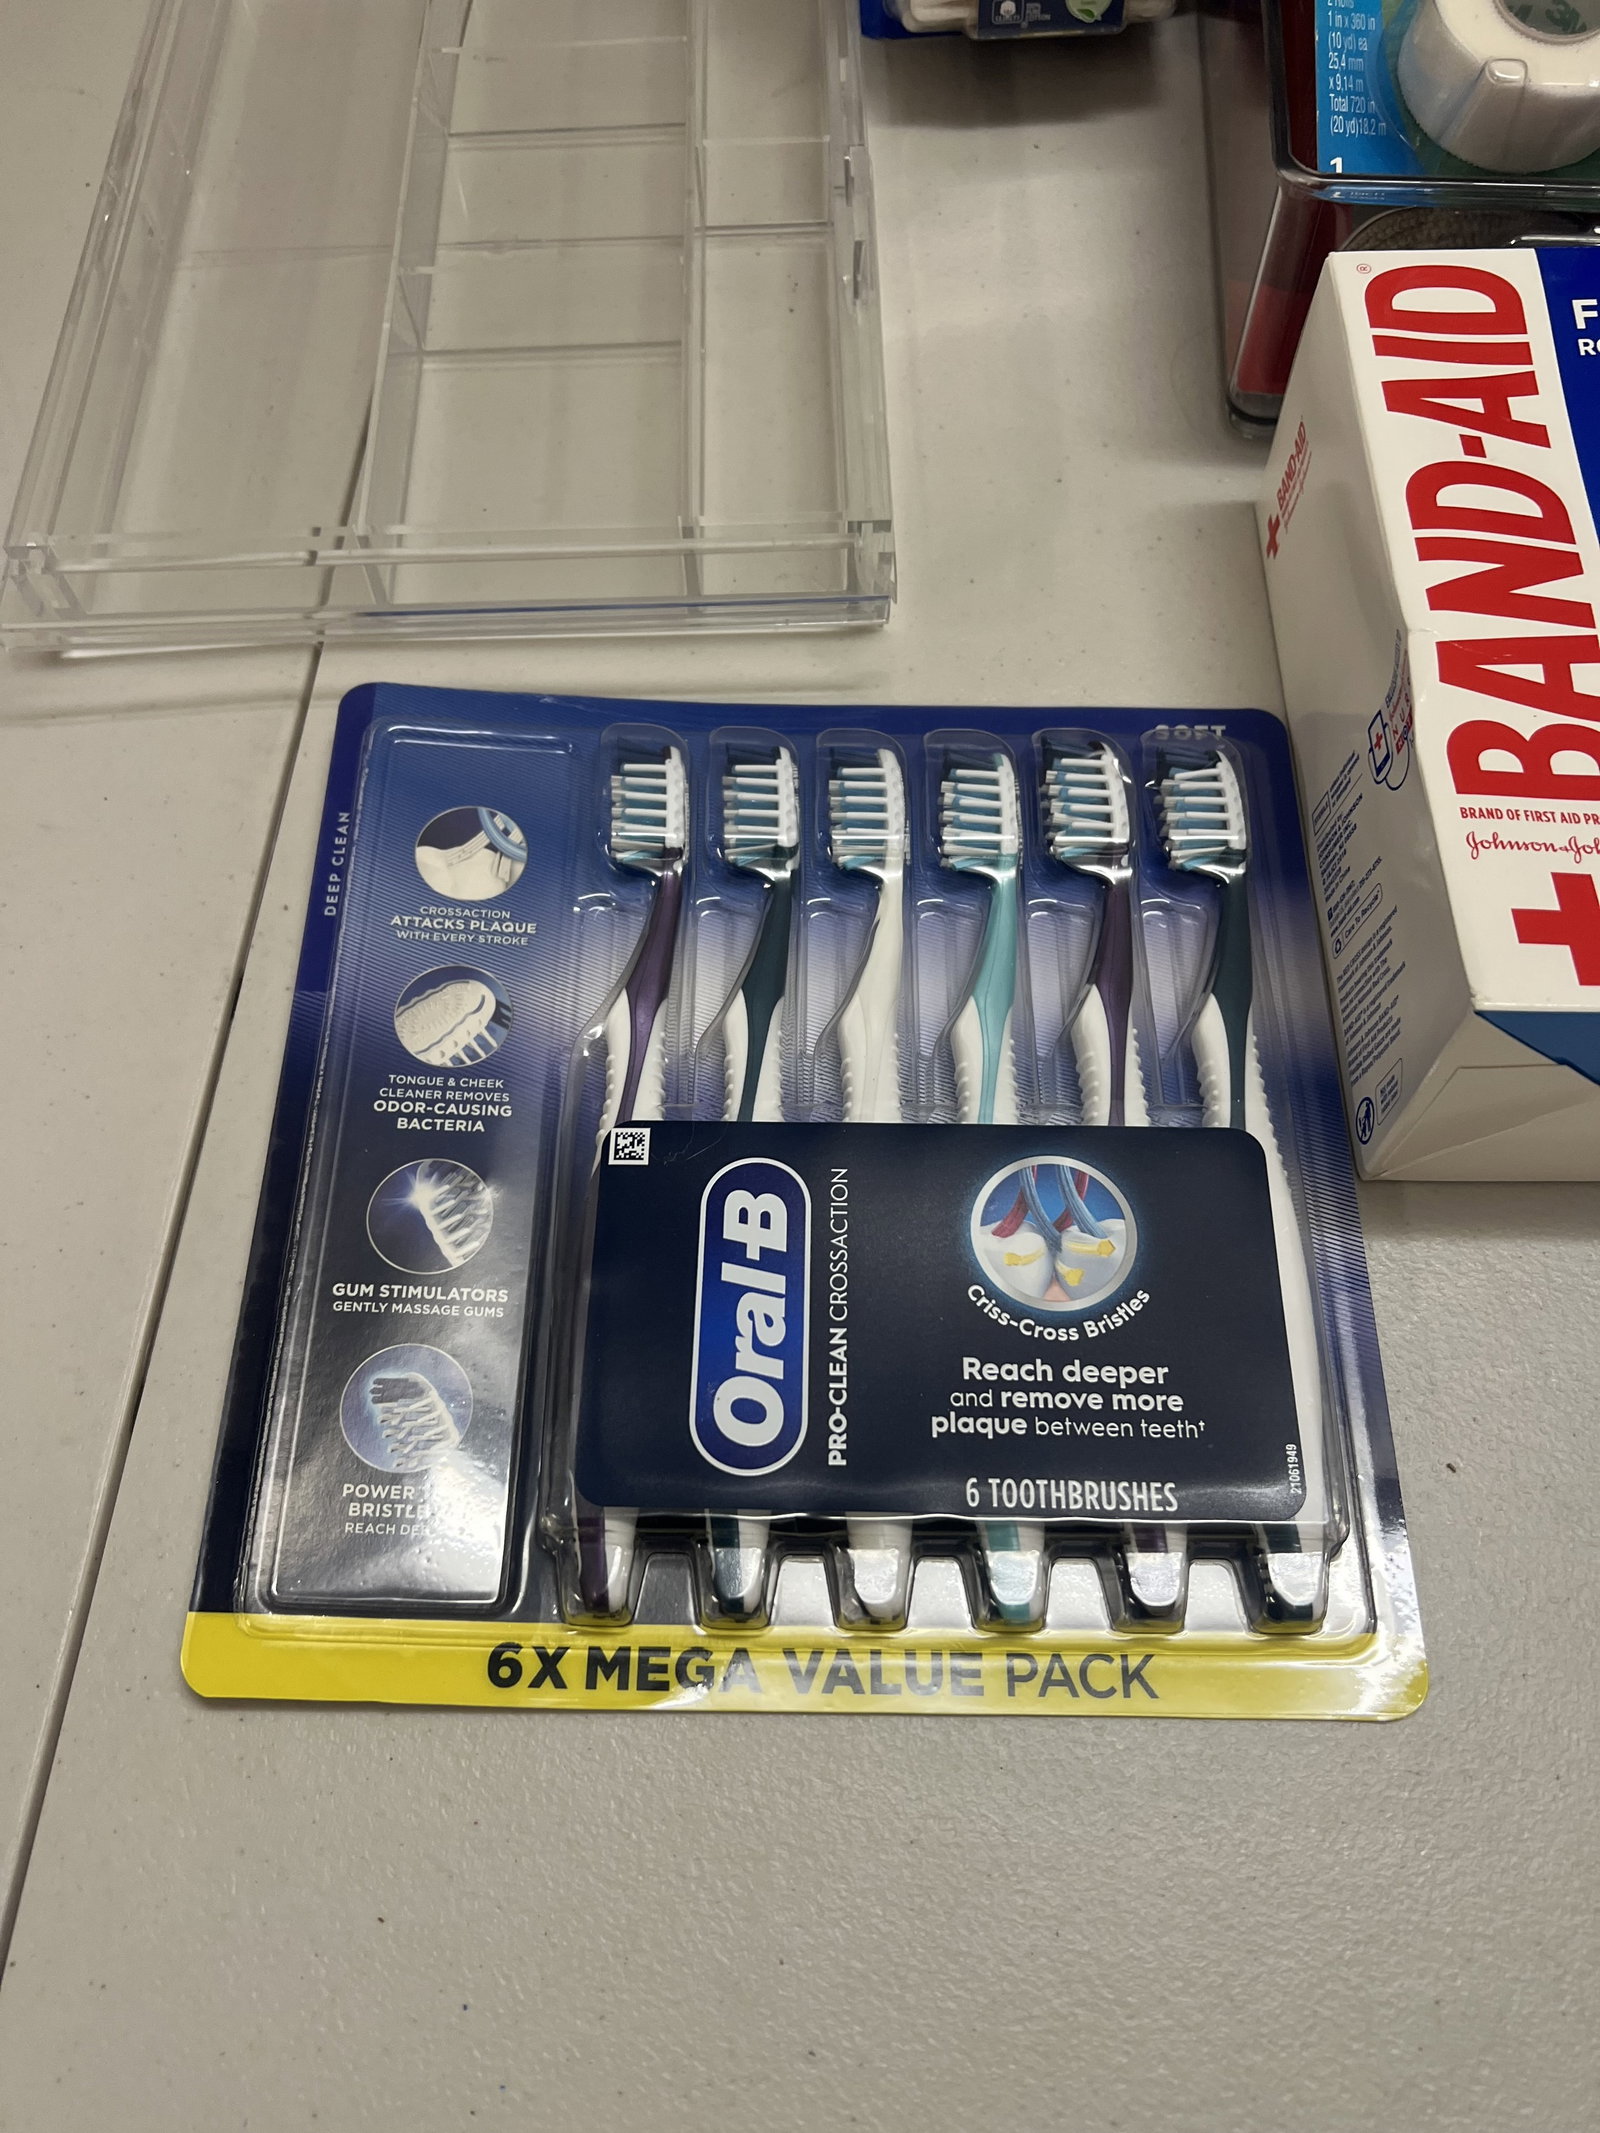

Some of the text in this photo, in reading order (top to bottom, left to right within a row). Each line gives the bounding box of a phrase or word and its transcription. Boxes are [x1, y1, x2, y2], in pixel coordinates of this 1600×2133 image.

[1328, 10, 1376, 31] 1 in x 360 in
[1328, 31, 1342, 52] (10
[1358, 37, 1368, 51] ea
[1329, 76, 1335, 90] x
[1329, 94, 1348, 112] Total
[1350, 95, 1365, 114] 720
[1330, 115, 1344, 136] (20
[1460, 806, 1503, 820] BRAND
[1506, 808, 1521, 821] OF
[1523, 809, 1557, 823] FIRST
[1560, 811, 1581, 824] AID
[1466, 830, 1558, 860] Johnson
[324, 812, 350, 917] DEEP CLEAN
[419, 906, 511, 920] CROSSACTION
[390, 914, 538, 935] ATTACKS PLAQUE
[395, 929, 530, 947] WITH EVERY STROKE
[388, 1074, 505, 1089] TONGUE & CHEEK
[379, 1087, 511, 1103] CLEANER REMOVES
[373, 1100, 513, 1118] ODOR-CAUSING
[396, 1117, 486, 1133] BACTERIA
[332, 1282, 510, 1304] GUM STIMULATORS
[332, 1301, 505, 1319] GENTLY MASSAGE GUMS
[713, 1188, 788, 1448] Oral-B
[828, 1168, 849, 1467] PRO-CLEAN CROSSACTION
[967, 1284, 1151, 1341] Criss-Cross Bristles
[962, 1356, 1169, 1389] Reach deeper
[950, 1389, 1184, 1412] and remove more
[931, 1411, 1028, 1440] plaque
[1035, 1416, 1134, 1437] between
[1285, 1443, 1303, 1495] 21061949
[341, 1483, 416, 1500] POWER
[965, 1477, 1179, 1512] 6 TOOTHBRUSHES
[344, 1522, 397, 1536] REACH
[487, 1641, 1161, 1700] 6X MEGA VALUE PACK
